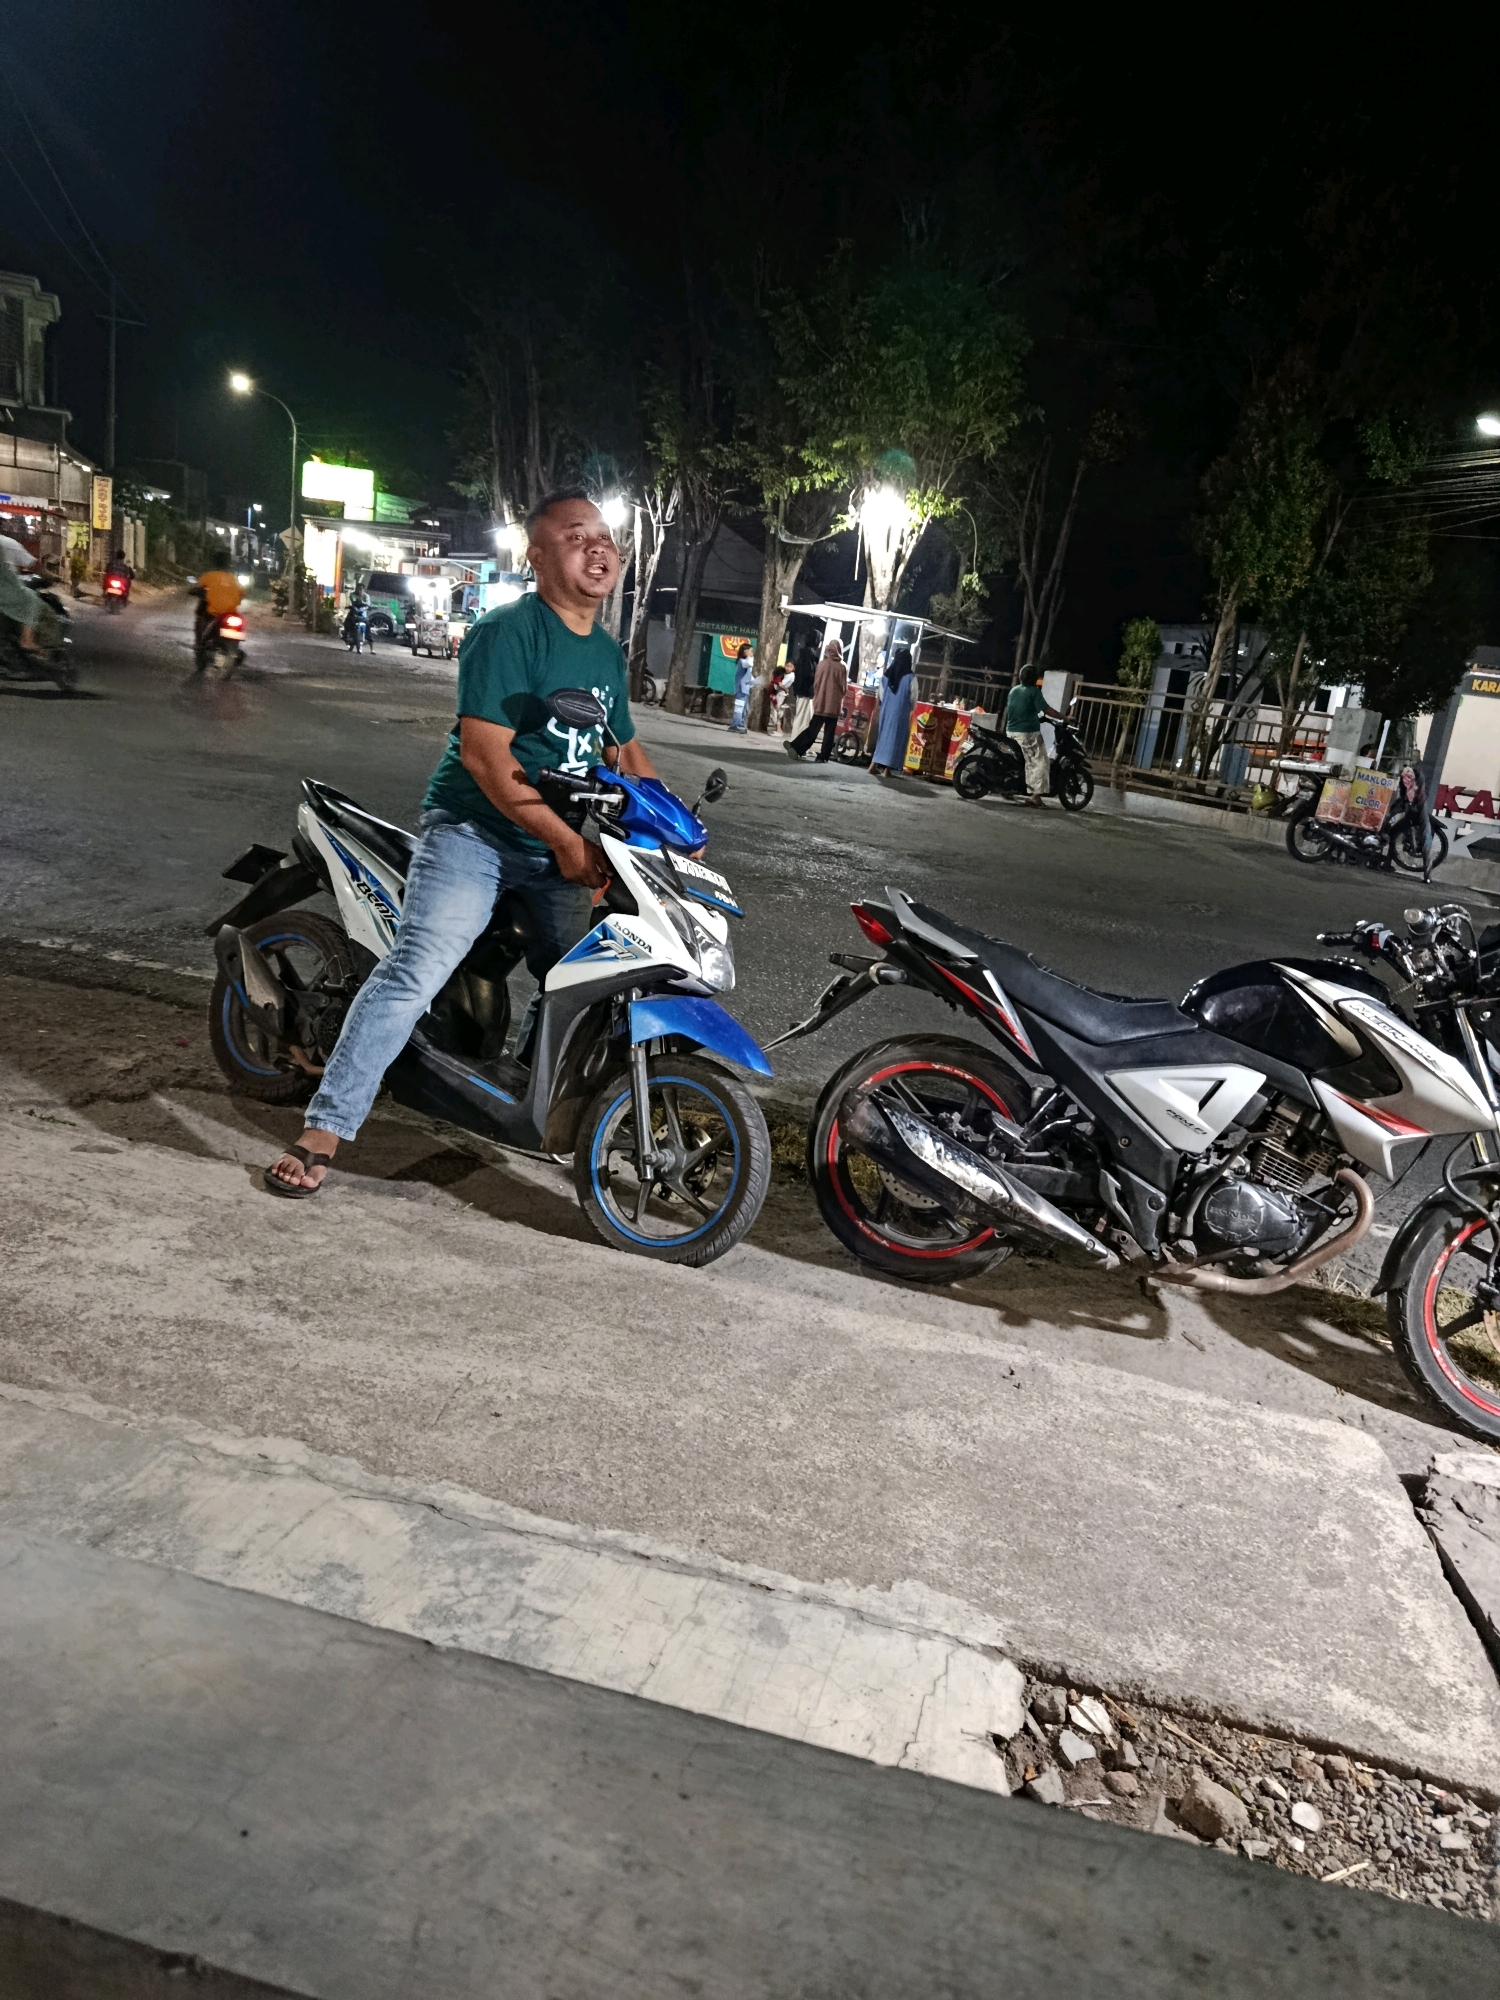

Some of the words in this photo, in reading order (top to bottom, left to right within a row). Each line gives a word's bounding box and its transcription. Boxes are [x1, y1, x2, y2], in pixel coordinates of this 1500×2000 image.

[1356, 772, 1393, 788] MAKLOR
[1355, 796, 1380, 808] CILOR
[1434, 783, 1500, 820] KA
